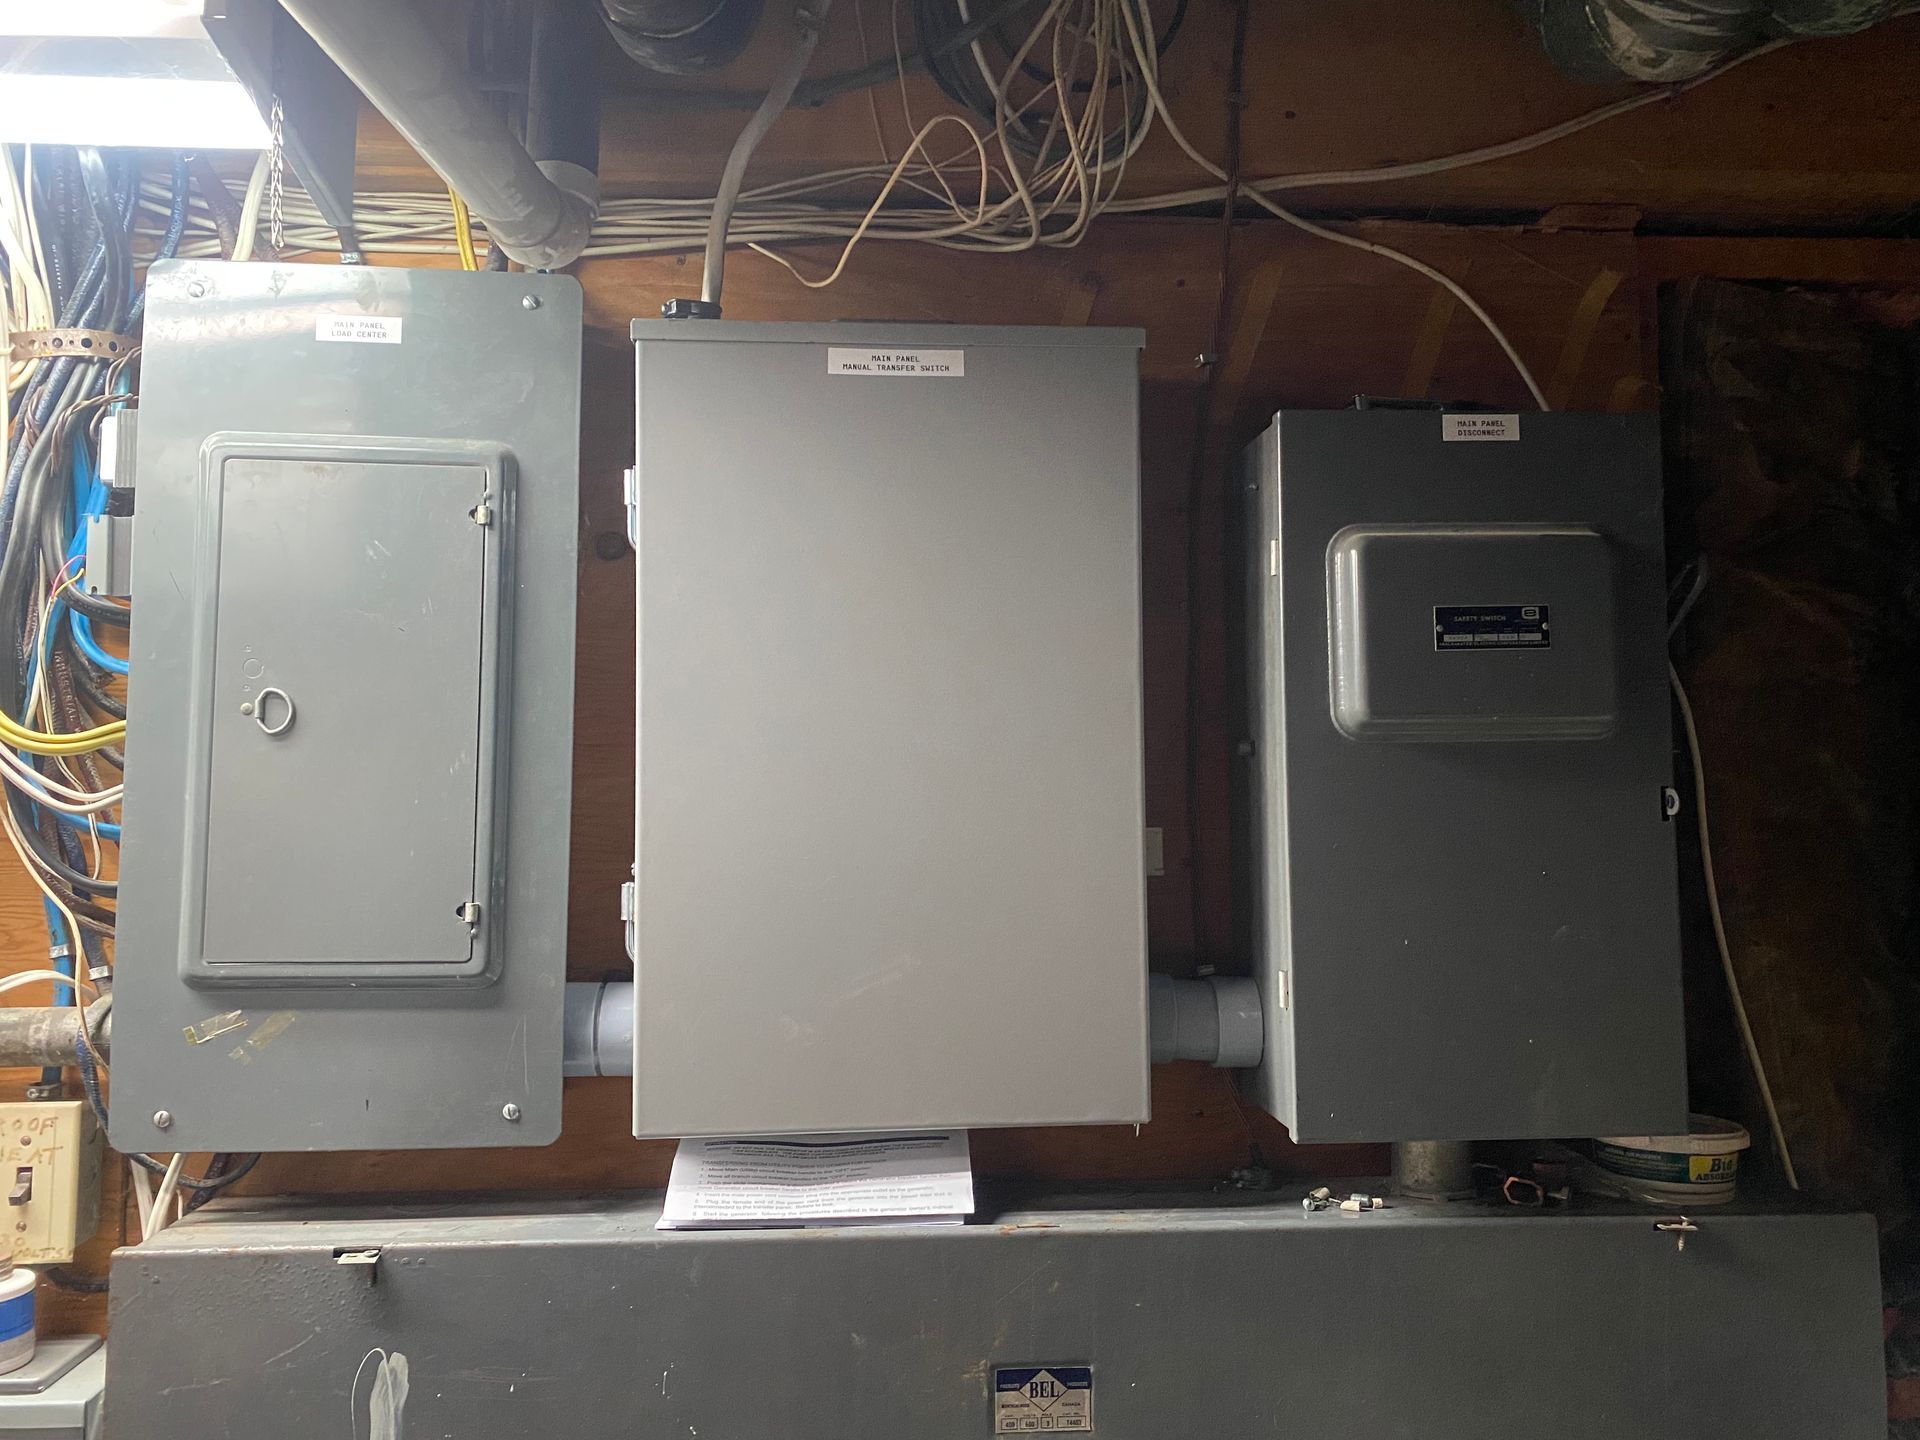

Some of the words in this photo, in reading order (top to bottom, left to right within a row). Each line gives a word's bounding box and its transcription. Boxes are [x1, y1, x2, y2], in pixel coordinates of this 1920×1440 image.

[356, 331, 387, 339] CENTER
[877, 364, 915, 372] TRANSFER
[1029, 1381, 1059, 1398] BEL
